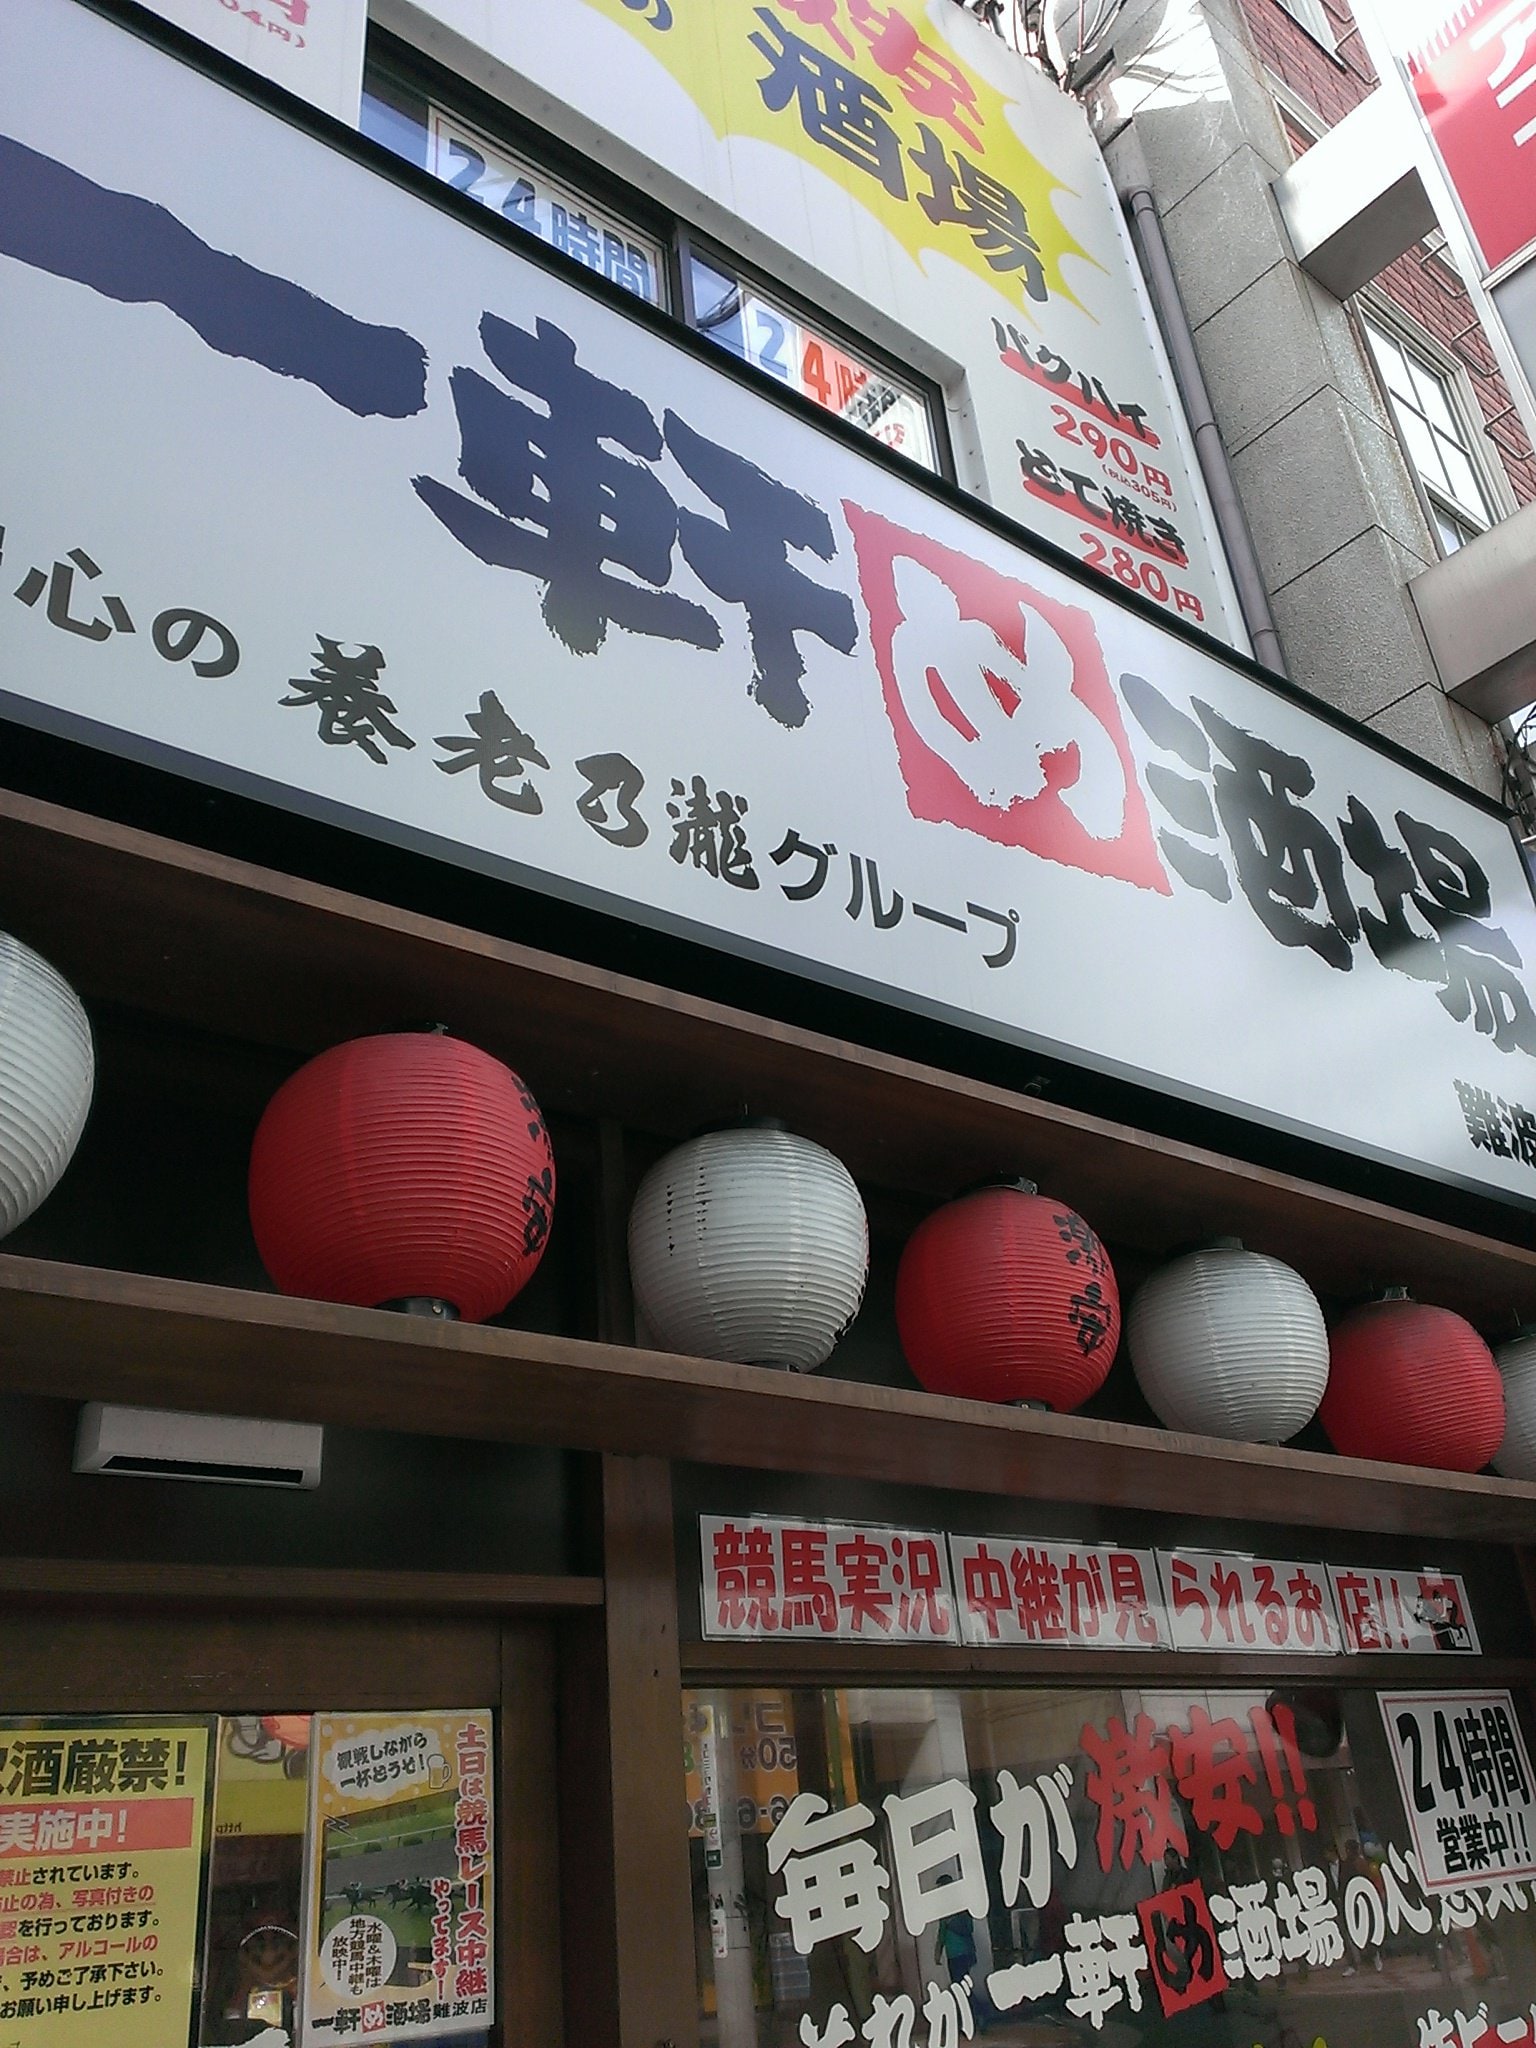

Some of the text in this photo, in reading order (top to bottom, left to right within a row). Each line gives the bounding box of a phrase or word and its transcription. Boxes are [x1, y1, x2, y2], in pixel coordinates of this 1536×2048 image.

[1051, 405, 1173, 496] 290円
[1016, 439, 1185, 560] どて焼き
[1080, 533, 1205, 622] 280円
[0, 1738, 187, 1797] 酒厳禁!
[337, 1732, 428, 1771] 観戦しながら
[340, 1753, 426, 1789] 一杯どうぞ!
[1396, 1704, 1532, 1813] 24時間
[456, 1723, 488, 1998] 土日は競馬レース中継
[0, 1884, 155, 1914] 止の為、写真付きの
[332, 1935, 348, 1981] 放映中!
[432, 1879, 450, 2000] やってます!
[0, 1960, 164, 1992] 、予めご了承下さい。
[312, 1998, 431, 2035] 一軒め酒場
